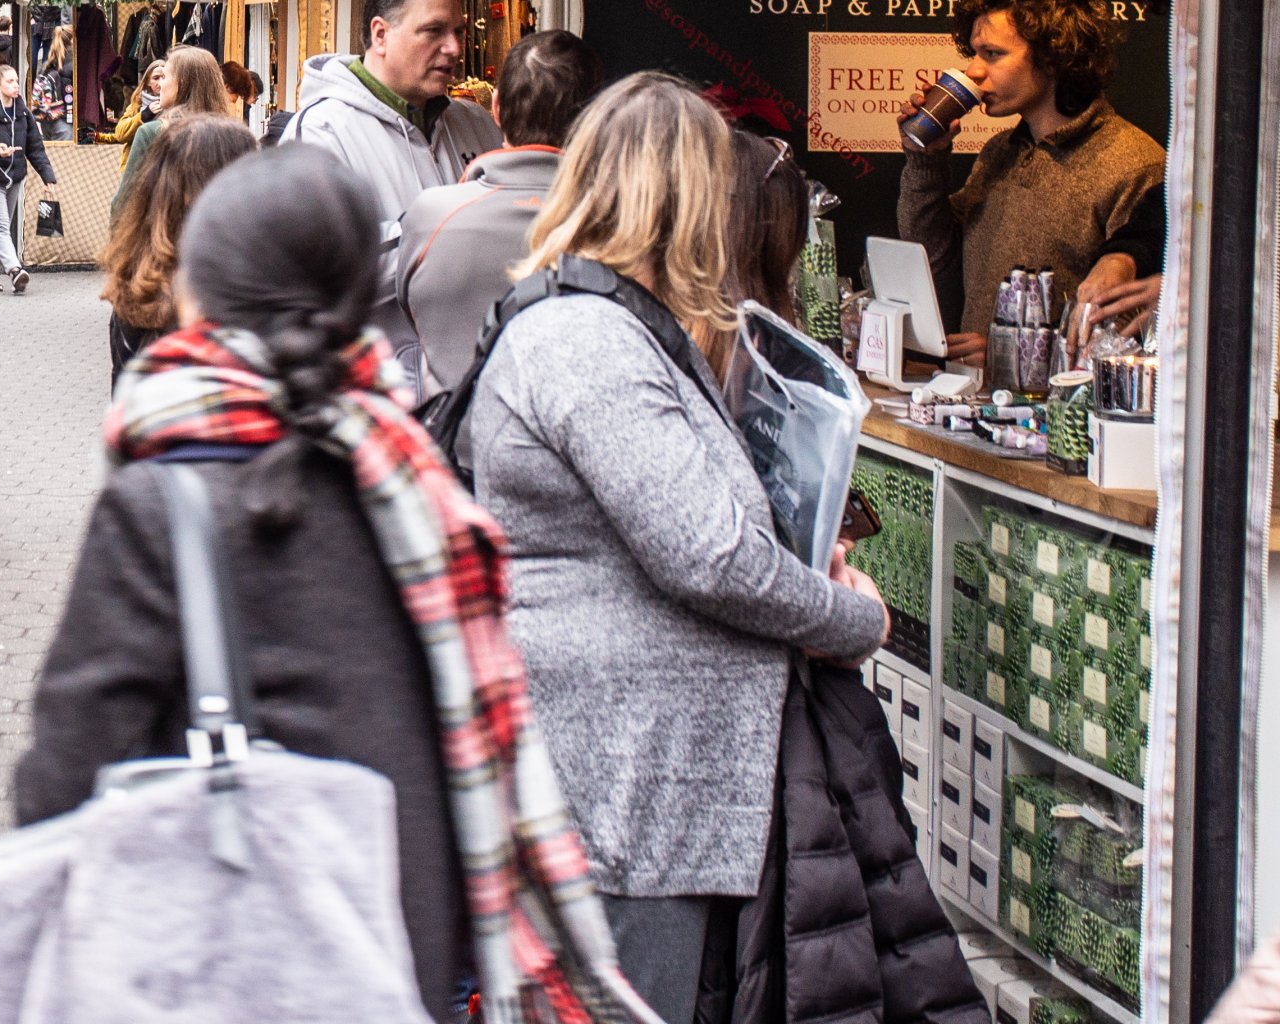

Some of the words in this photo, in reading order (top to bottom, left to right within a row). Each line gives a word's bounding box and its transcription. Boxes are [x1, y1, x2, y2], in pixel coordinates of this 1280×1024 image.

[828, 67, 905, 91] FREE
[827, 99, 860, 114] ON
[972, 123, 988, 133] the
